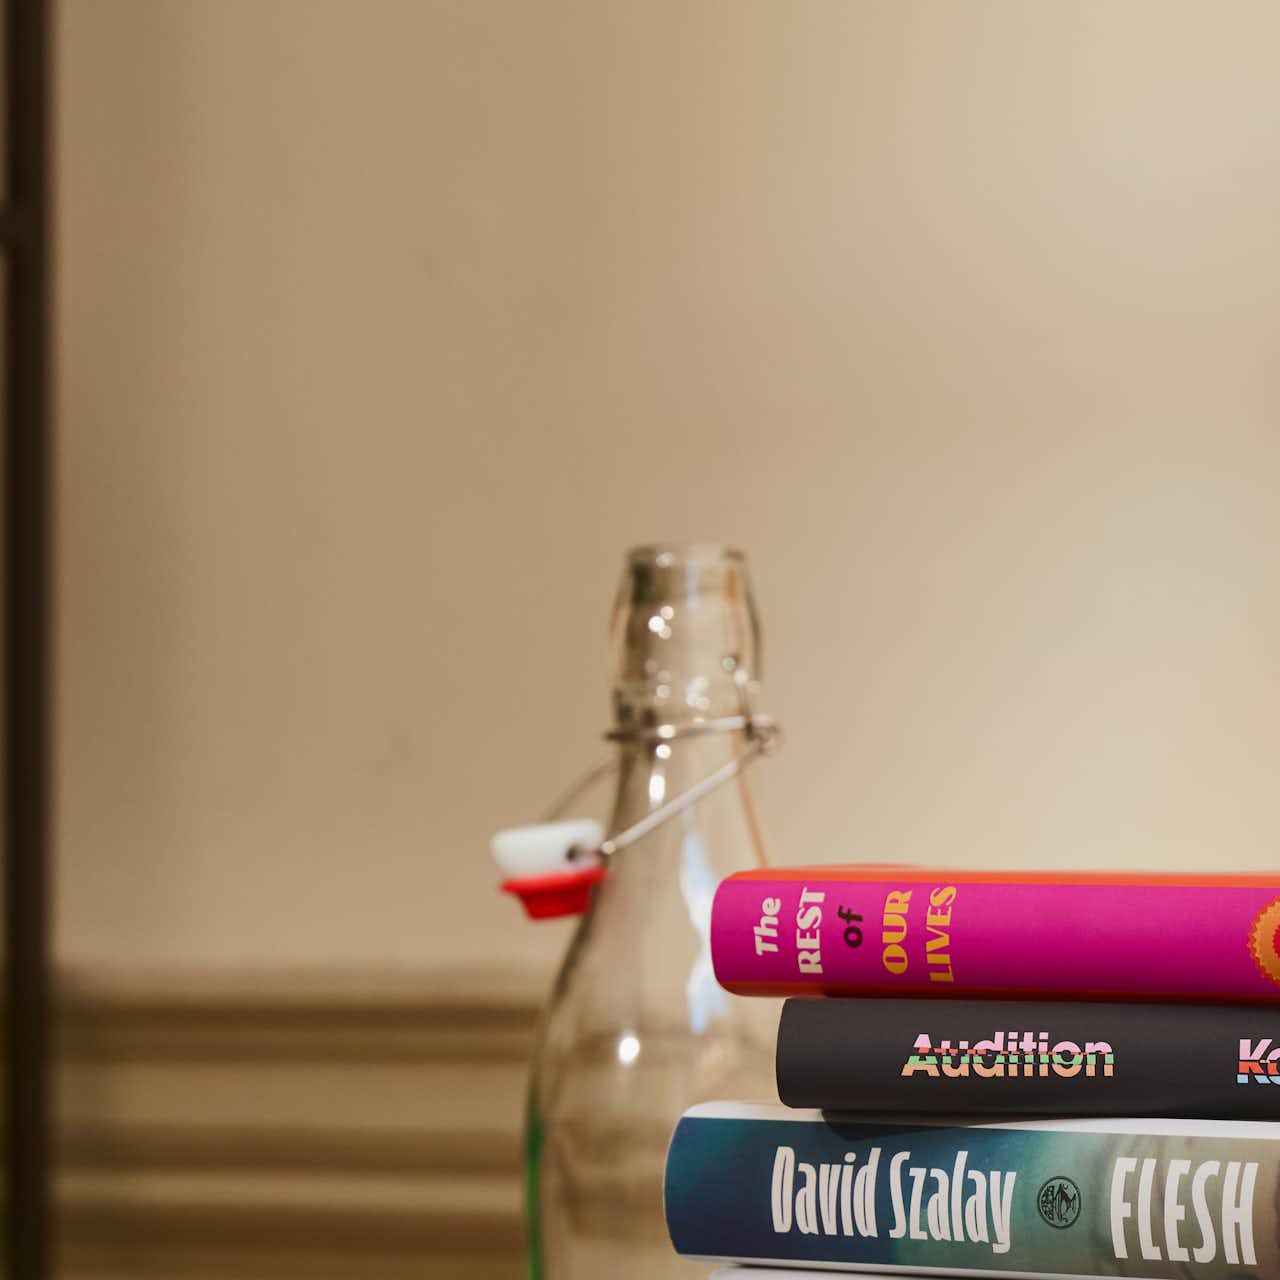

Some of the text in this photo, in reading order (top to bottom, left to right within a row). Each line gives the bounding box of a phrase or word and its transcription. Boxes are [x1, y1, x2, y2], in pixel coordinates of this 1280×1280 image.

[753, 897, 781, 956] The
[796, 887, 825, 974] REST
[838, 905, 863, 948] of
[882, 889, 912, 974] OUR
[925, 886, 957, 982] LIVES
[901, 1031, 1115, 1078] Audition
[771, 1145, 1018, 1254] David Szalay
[1110, 1156, 1260, 1266] FLESH
